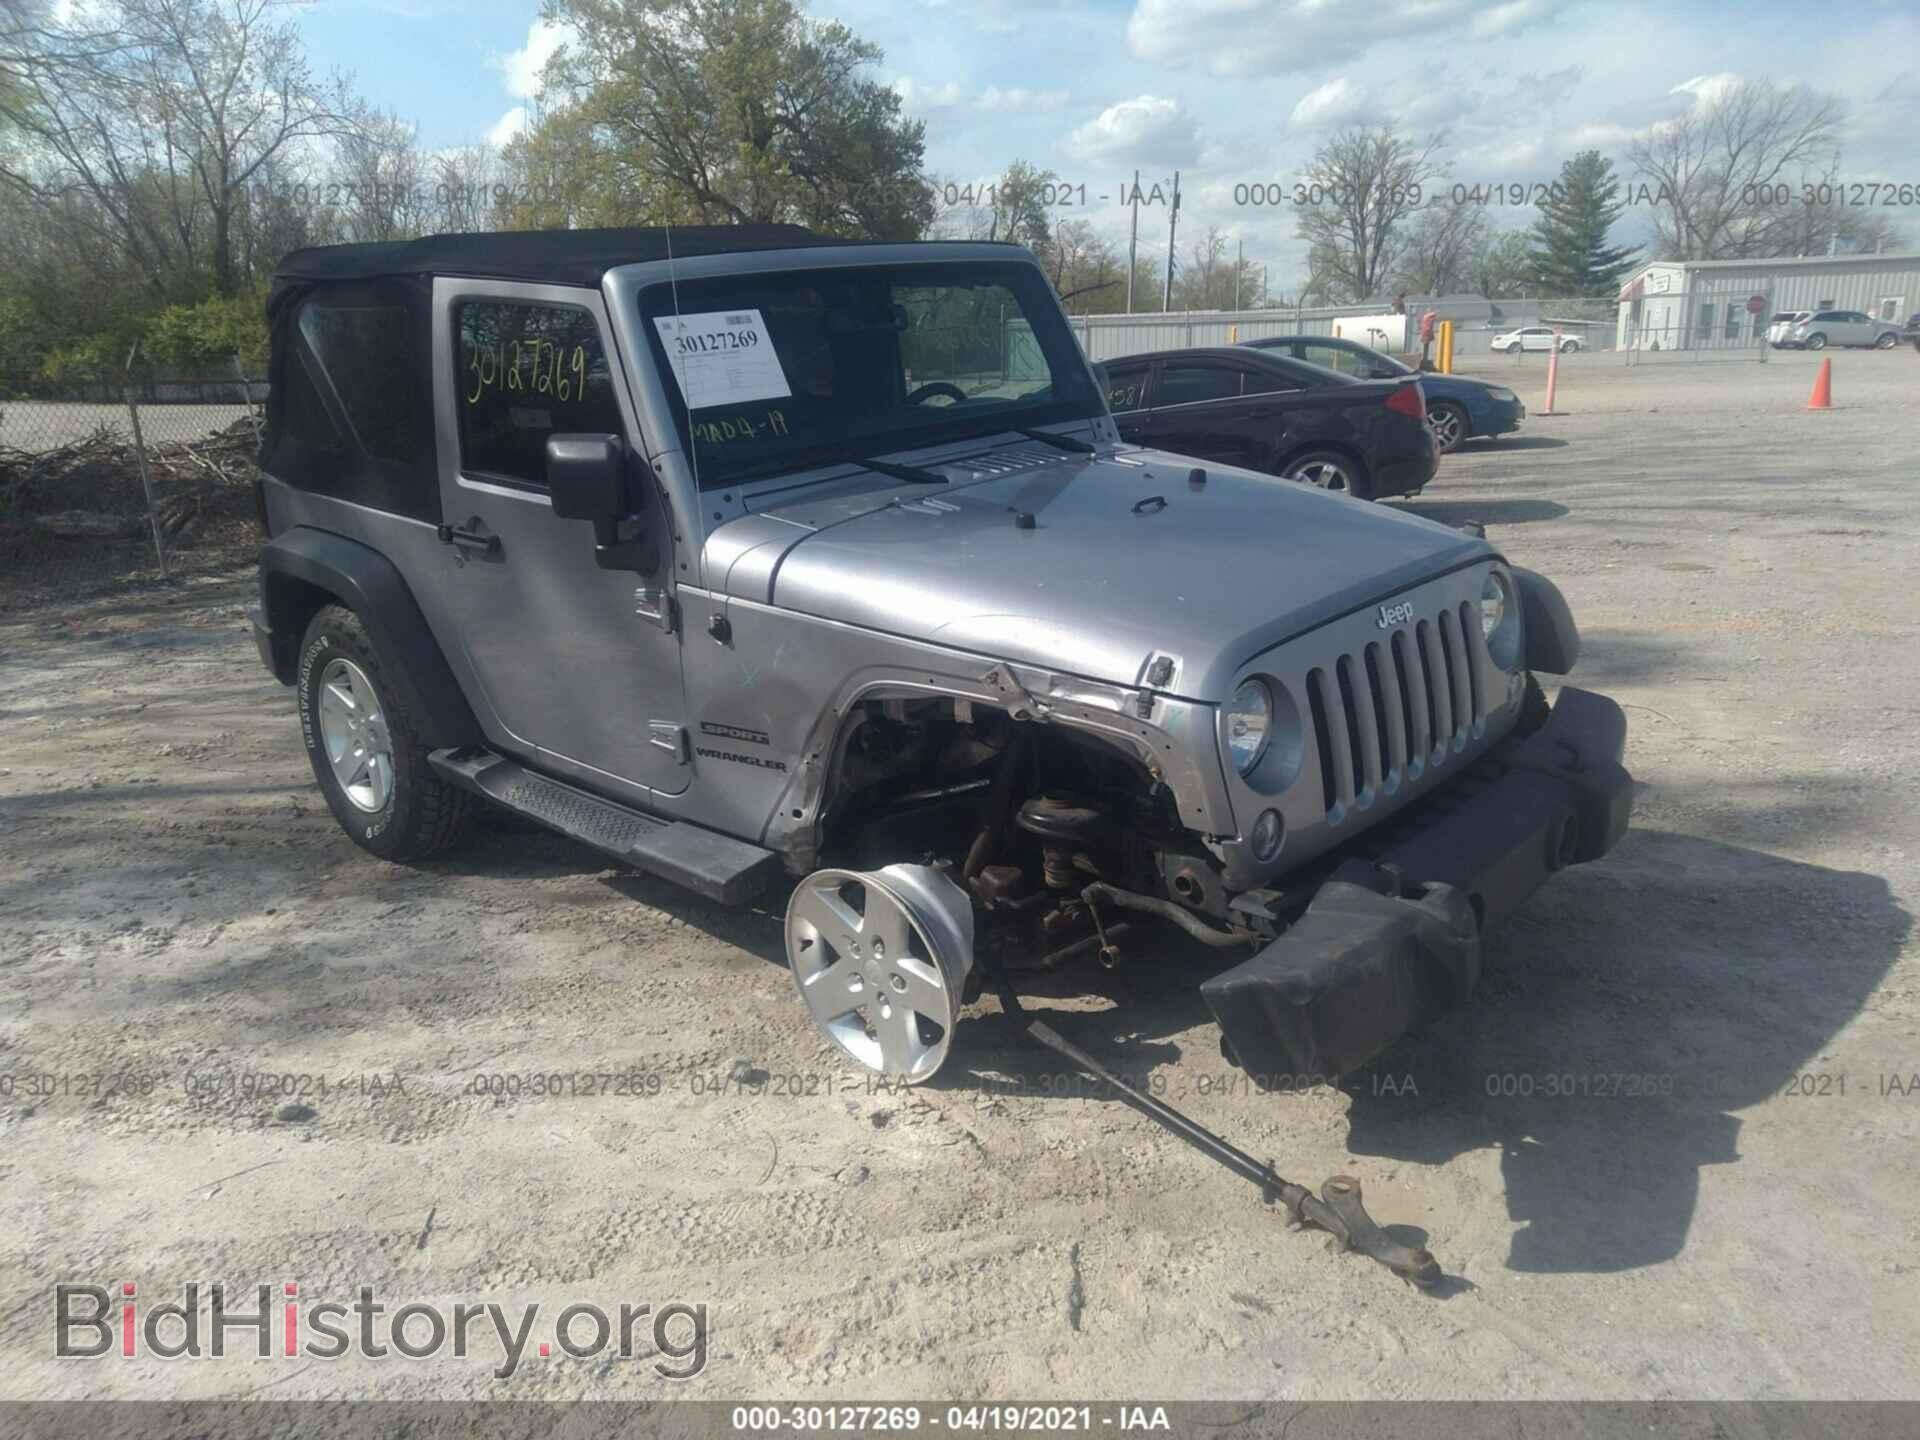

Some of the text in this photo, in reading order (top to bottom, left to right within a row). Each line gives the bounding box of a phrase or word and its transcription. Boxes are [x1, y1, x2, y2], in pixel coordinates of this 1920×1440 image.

[674, 329, 758, 354] 30127269
[468, 339, 584, 403] 30127269
[1378, 602, 1414, 629] Jeep
[702, 723, 769, 744] SPORT
[696, 747, 787, 773] WRANGLER
